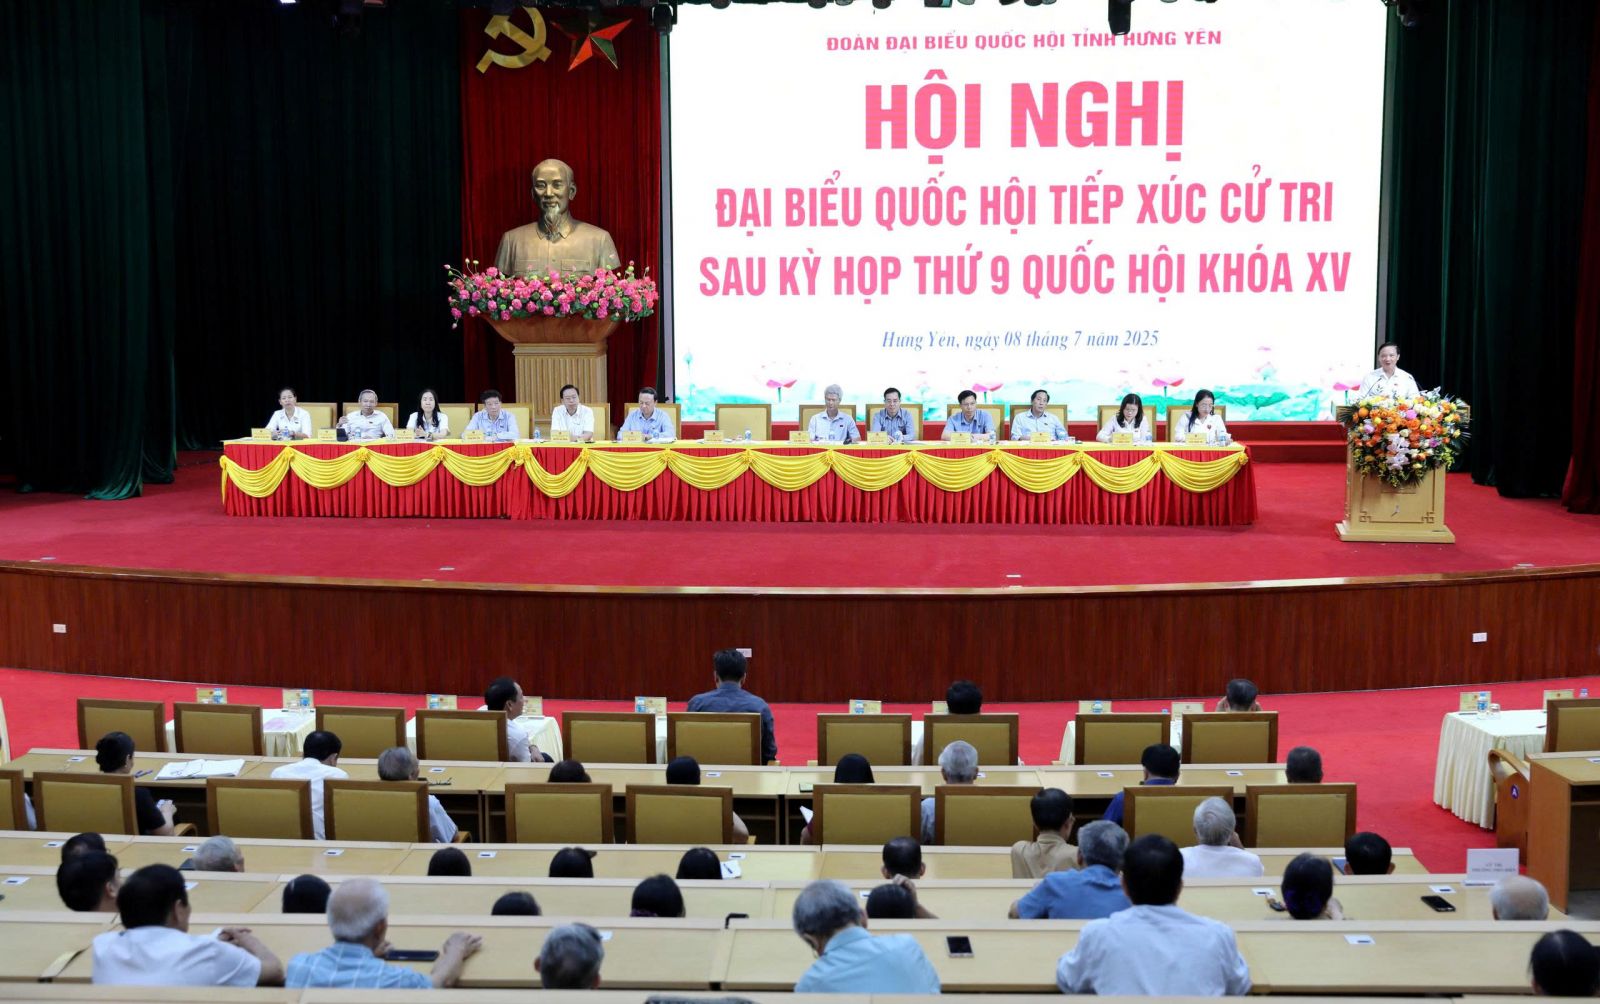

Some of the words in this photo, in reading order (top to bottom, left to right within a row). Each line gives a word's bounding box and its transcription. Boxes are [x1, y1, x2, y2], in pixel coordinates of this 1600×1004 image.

[826, 34, 879, 51] ĐOÀN
[886, 36, 917, 54] ĐẠI
[975, 30, 1026, 50] QUỐC
[1033, 31, 1065, 51] HỘI
[1123, 31, 1176, 46] HƯNG
[1184, 28, 1222, 45] YÊN
[866, 69, 981, 164] HỘI
[1011, 80, 1184, 162] NGHỊ
[716, 187, 772, 237] ĐẠI
[786, 170, 862, 228] BIỂU
[875, 170, 967, 230] QUỐC
[980, 176, 1037, 235] HỘI
[1050, 170, 1124, 226] TIẾP
[1137, 176, 1207, 225] XÚC
[1221, 164, 1273, 224] CỬ
[1280, 181, 1334, 223] TRI
[699, 256, 766, 297] SAU
[779, 247, 821, 296] KỲ
[833, 255, 901, 305] HỌP
[913, 243, 983, 295] THỨ
[990, 255, 1010, 295] 9
[1022, 239, 1115, 300] QUỐC
[1128, 244, 1185, 303] HỘI
[1199, 243, 1293, 293] KHÓA
[1305, 251, 1352, 293] XV
[1004, 330, 1021, 347] 08
[1026, 331, 1068, 350] tháng
[1073, 330, 1083, 347] 7
[1086, 334, 1119, 347] năm
[1123, 330, 1159, 347] 2025
